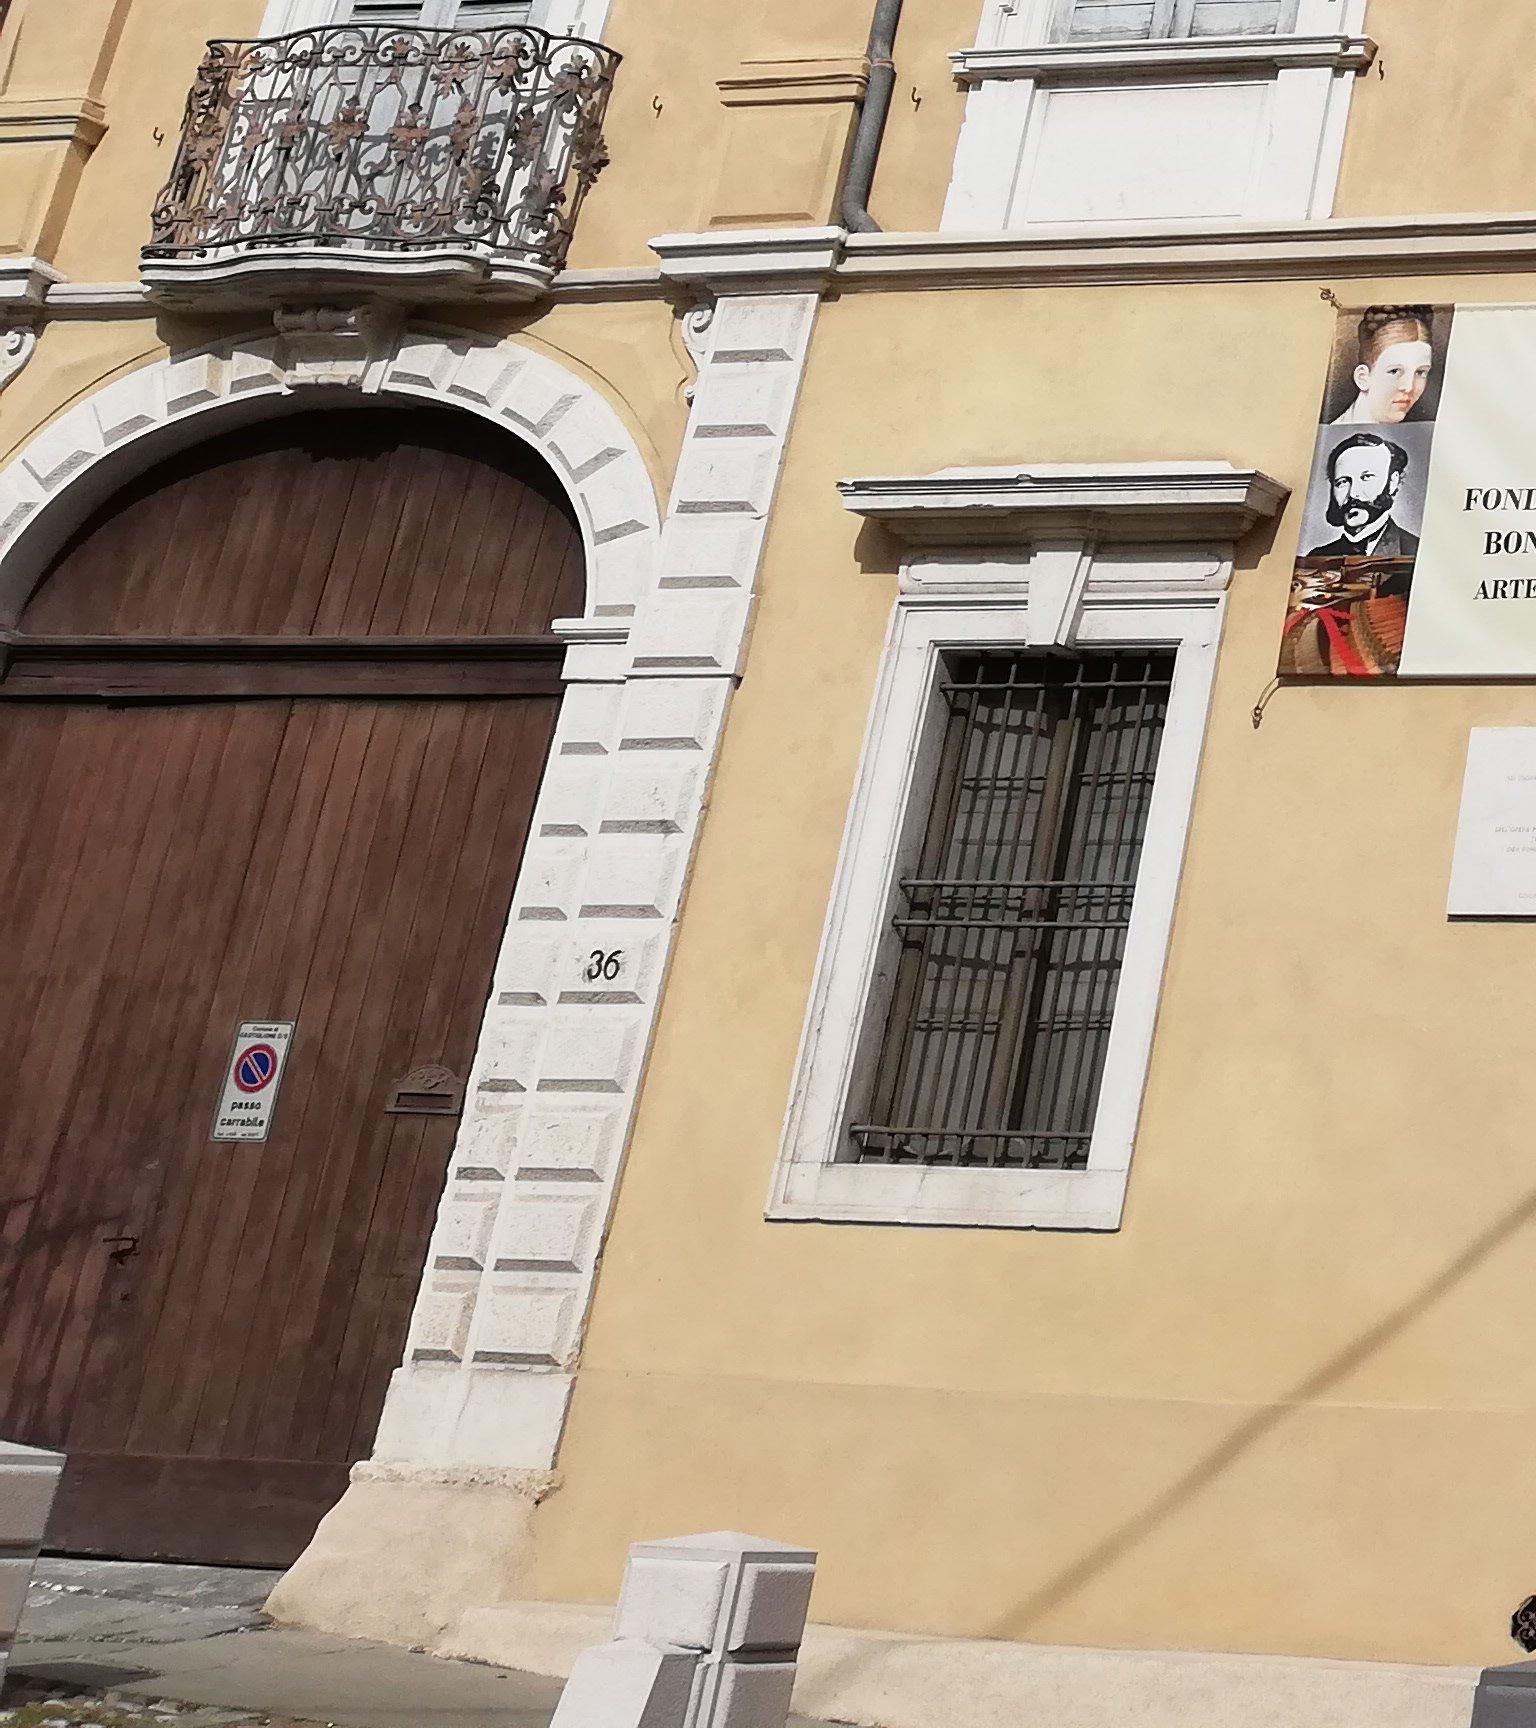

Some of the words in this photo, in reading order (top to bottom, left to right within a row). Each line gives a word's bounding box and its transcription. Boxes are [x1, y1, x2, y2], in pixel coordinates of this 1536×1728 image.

[586, 949, 624, 981] 36
[231, 1101, 262, 1112] passo
[219, 1116, 265, 1128] carrabile
